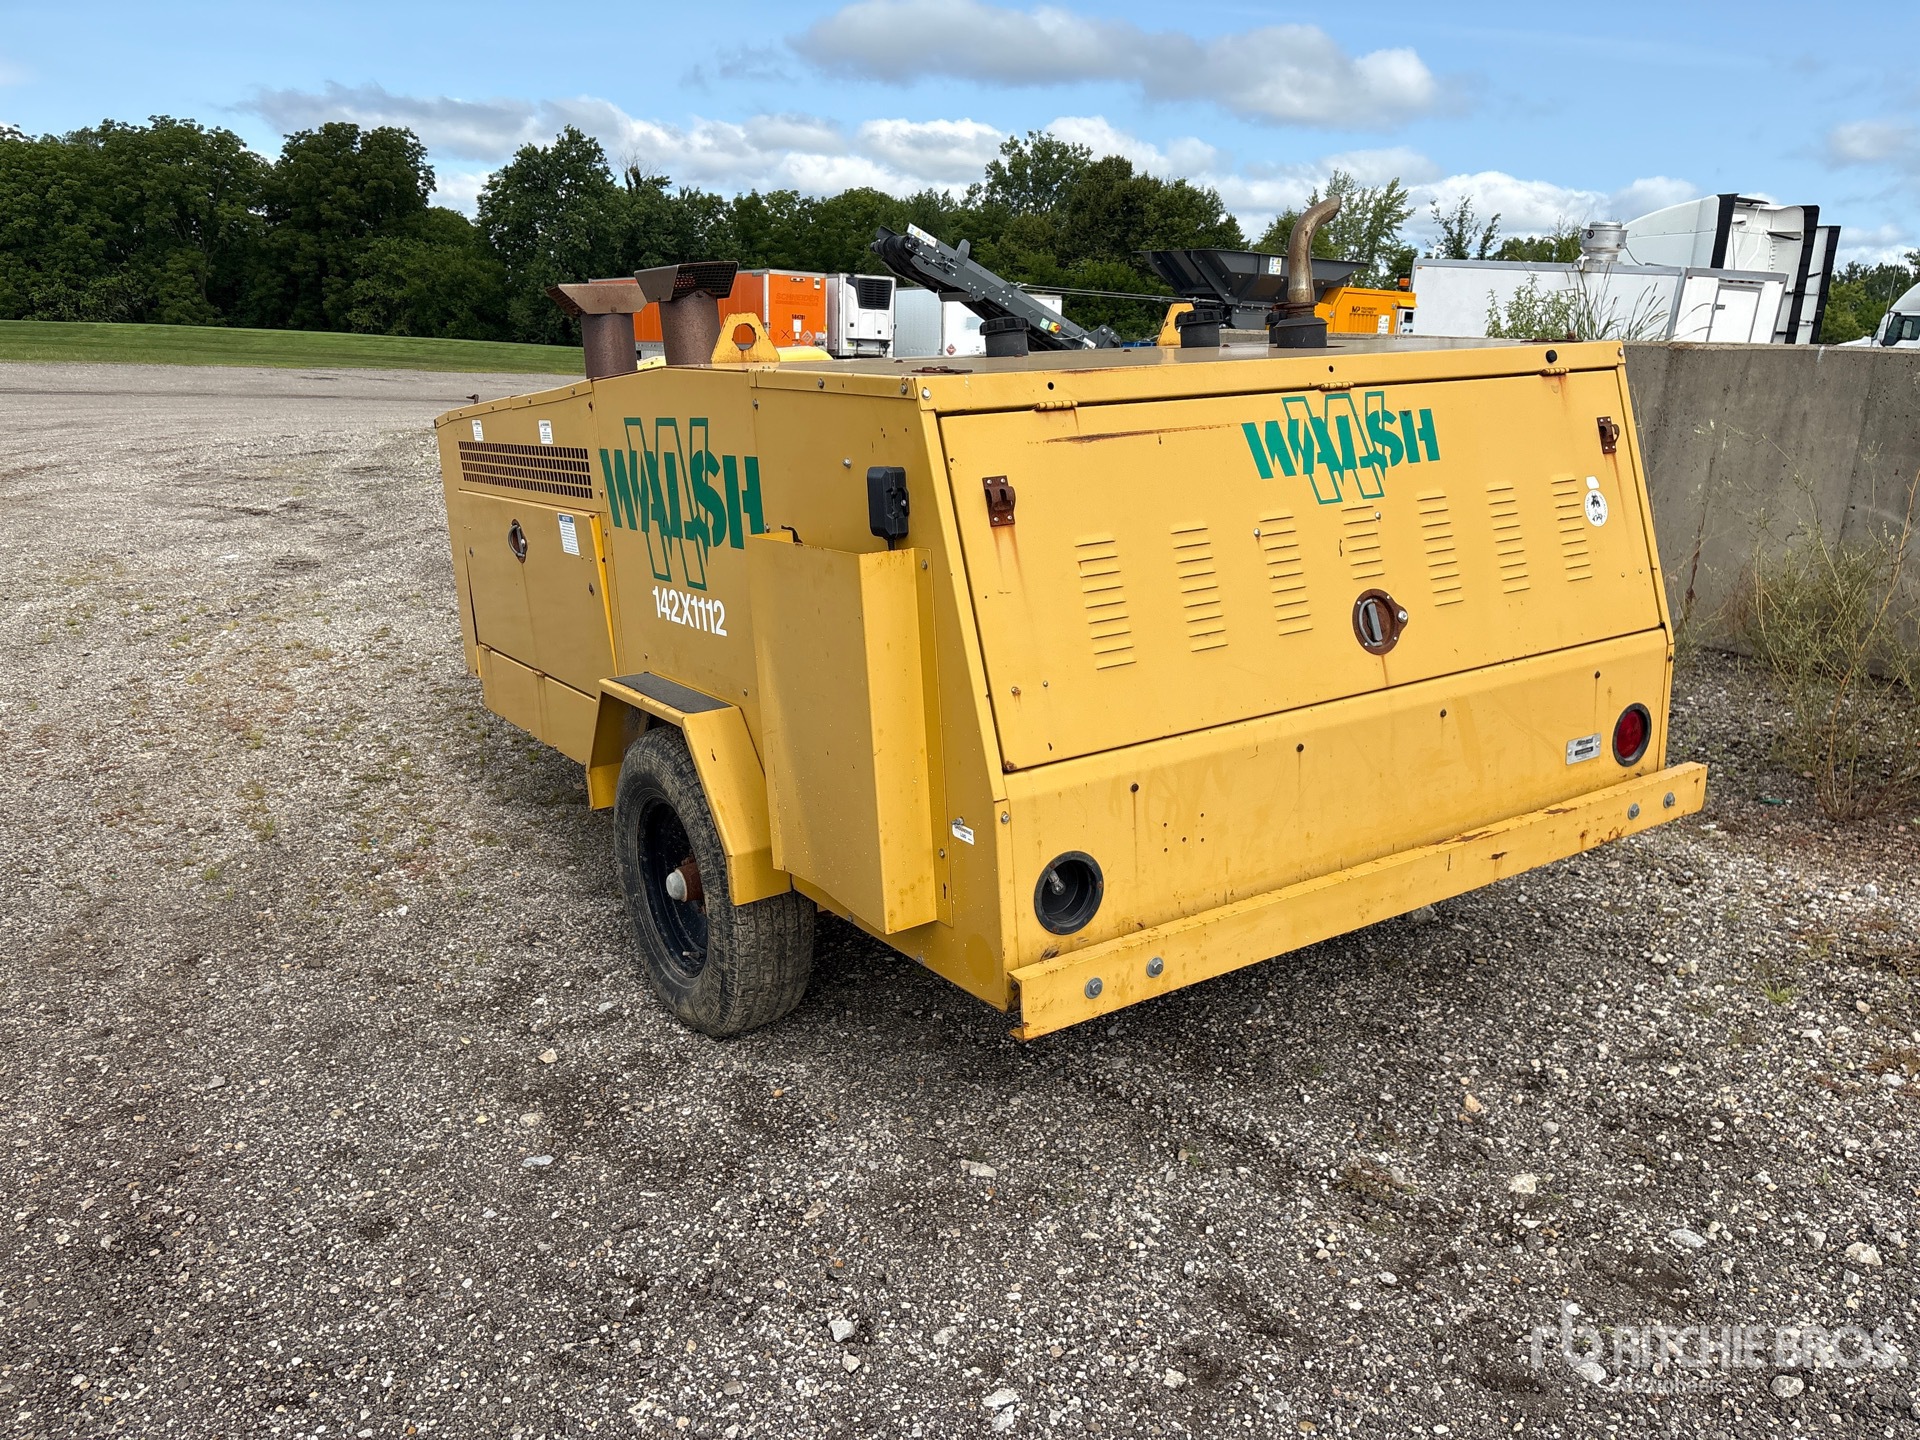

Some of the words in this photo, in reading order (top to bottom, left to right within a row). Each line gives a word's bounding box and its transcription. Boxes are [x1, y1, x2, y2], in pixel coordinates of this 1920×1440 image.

[1241, 407, 1440, 480] WALSH
[599, 447, 764, 549] WALSH
[652, 586, 728, 637] 142X1112
